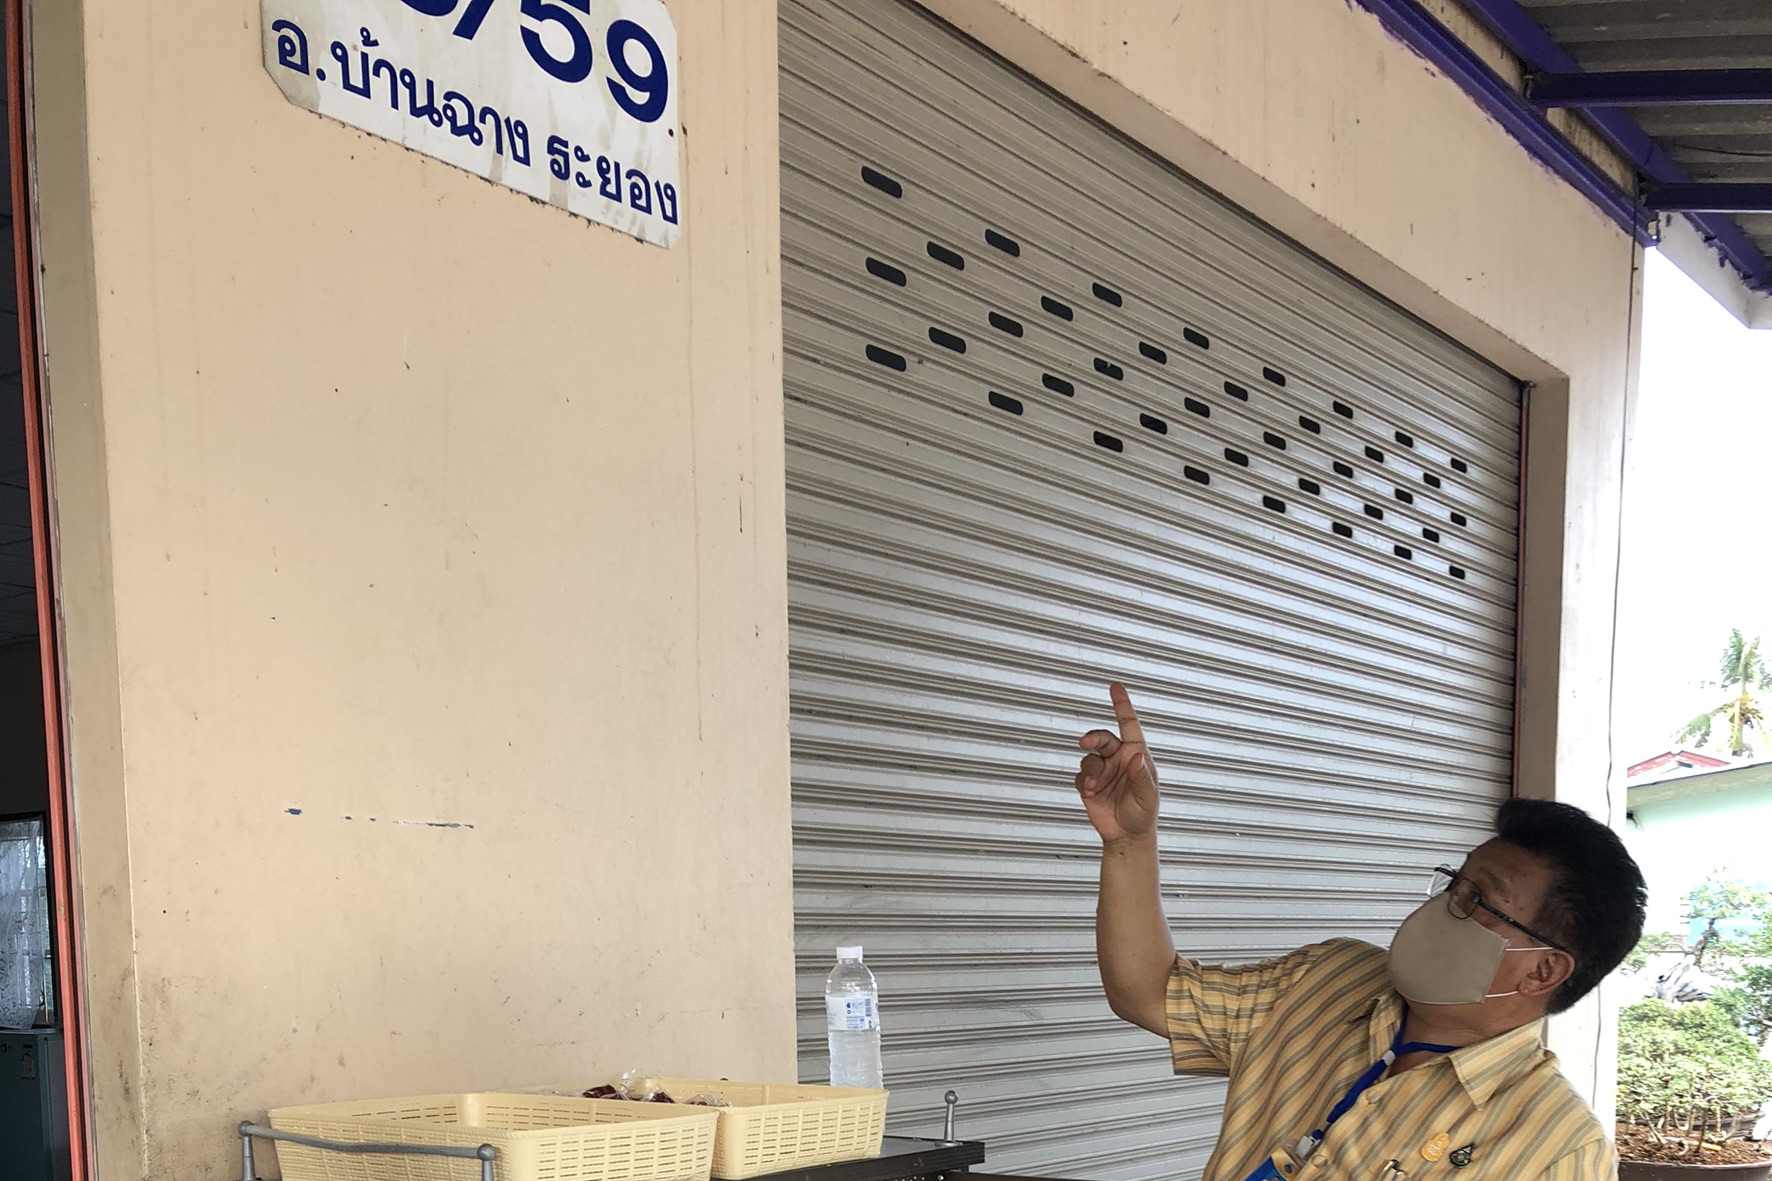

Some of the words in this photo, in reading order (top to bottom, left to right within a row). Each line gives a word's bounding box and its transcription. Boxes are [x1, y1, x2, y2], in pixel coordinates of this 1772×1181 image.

[271, 20, 531, 167] อ.บ้านฉาง
[547, 134, 679, 225] ระยอง
